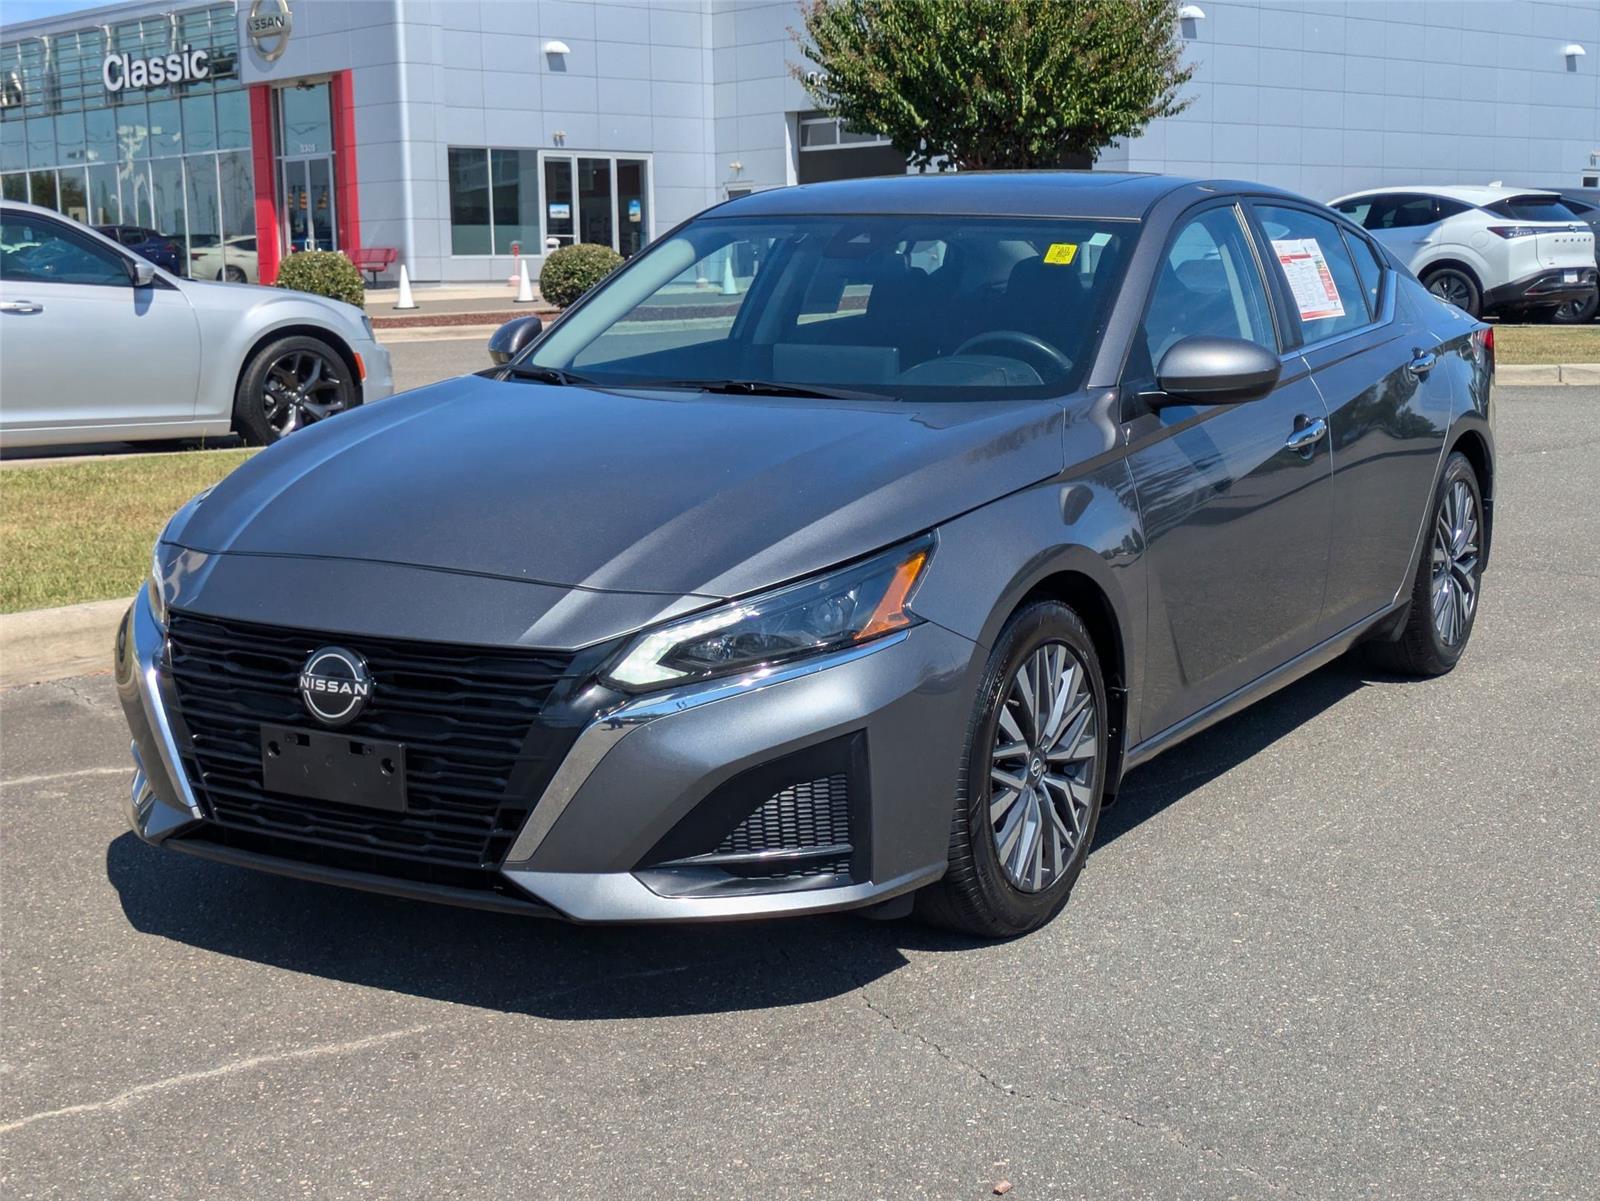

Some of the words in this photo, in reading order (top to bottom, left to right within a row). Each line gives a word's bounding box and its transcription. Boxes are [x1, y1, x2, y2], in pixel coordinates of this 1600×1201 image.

[247, 16, 285, 31] NSSAN
[103, 44, 209, 91] Classic
[300, 676, 367, 695] NISSAN
